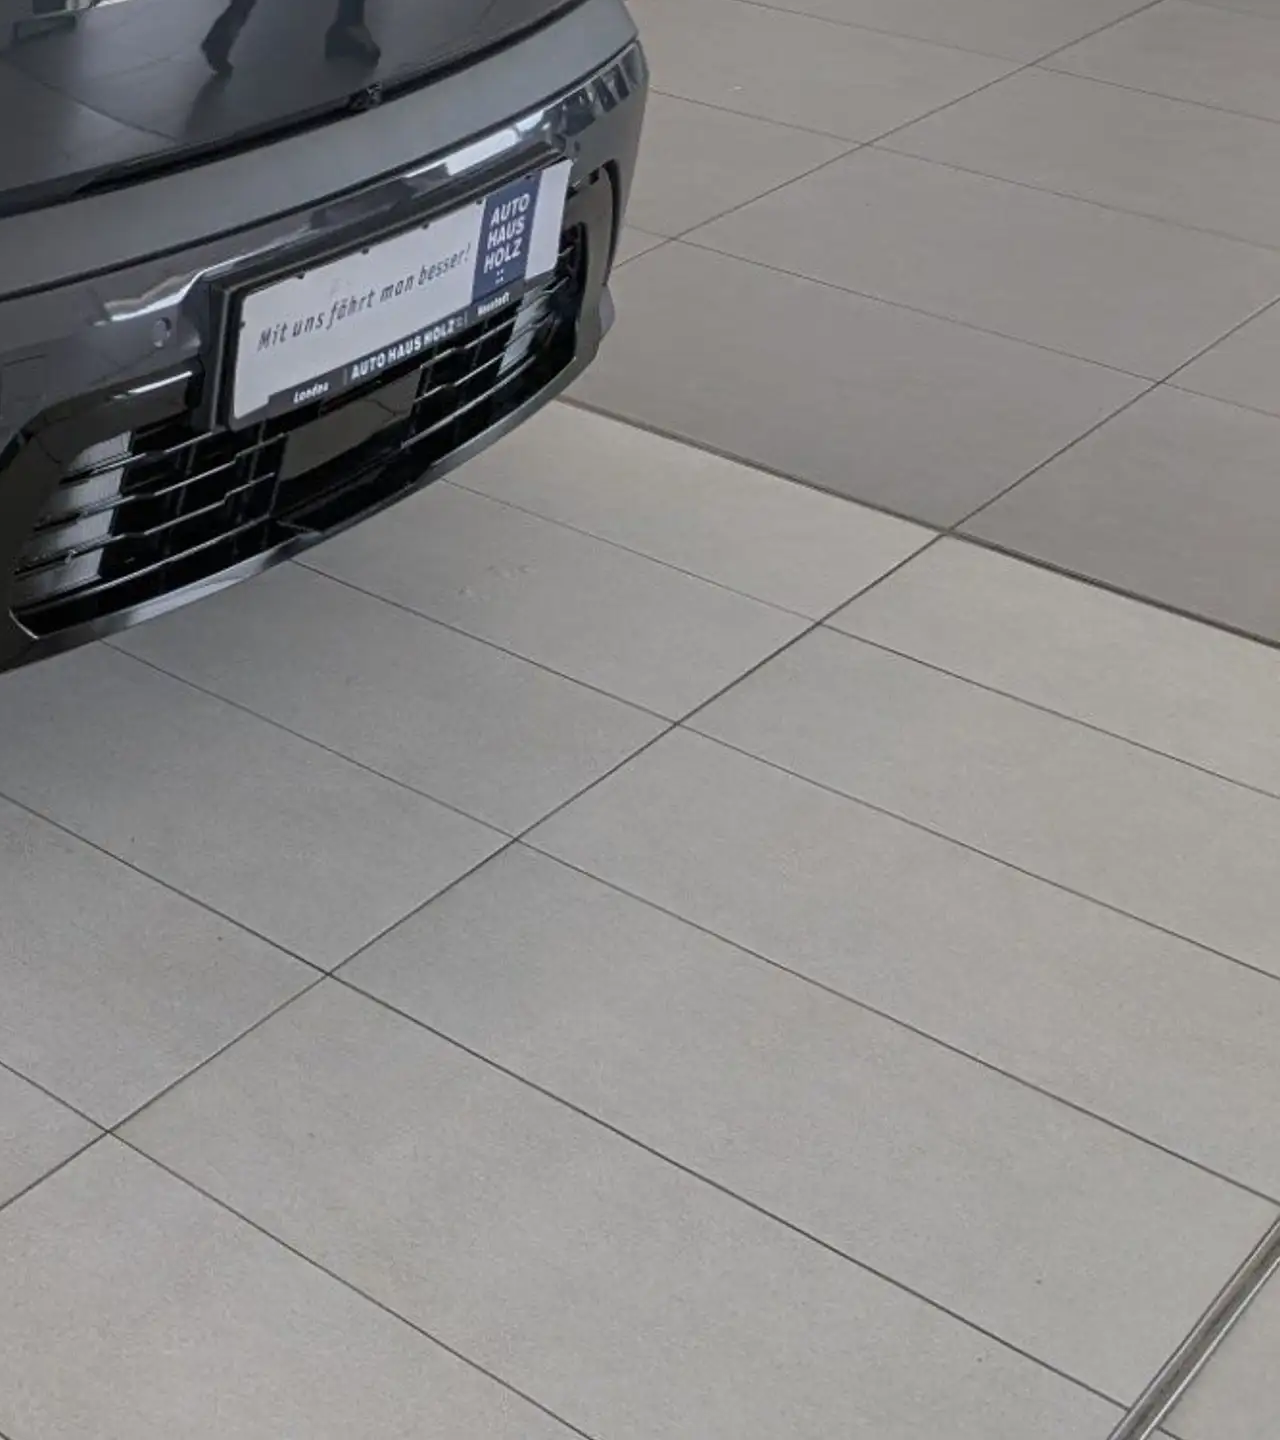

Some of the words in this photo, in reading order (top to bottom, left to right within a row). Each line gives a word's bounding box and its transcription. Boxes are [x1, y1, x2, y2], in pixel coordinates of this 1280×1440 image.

[490, 192, 531, 229] AUTO
[486, 215, 527, 251] HAUS
[482, 237, 523, 275] HOLZ
[257, 322, 288, 353] Mit
[292, 311, 326, 338] uns
[325, 289, 376, 331] fährt
[380, 274, 415, 303] man
[417, 240, 472, 286] besser!
[351, 353, 385, 381] AUTO
[387, 335, 423, 362] HAUS
[423, 318, 456, 348] HOLZ
